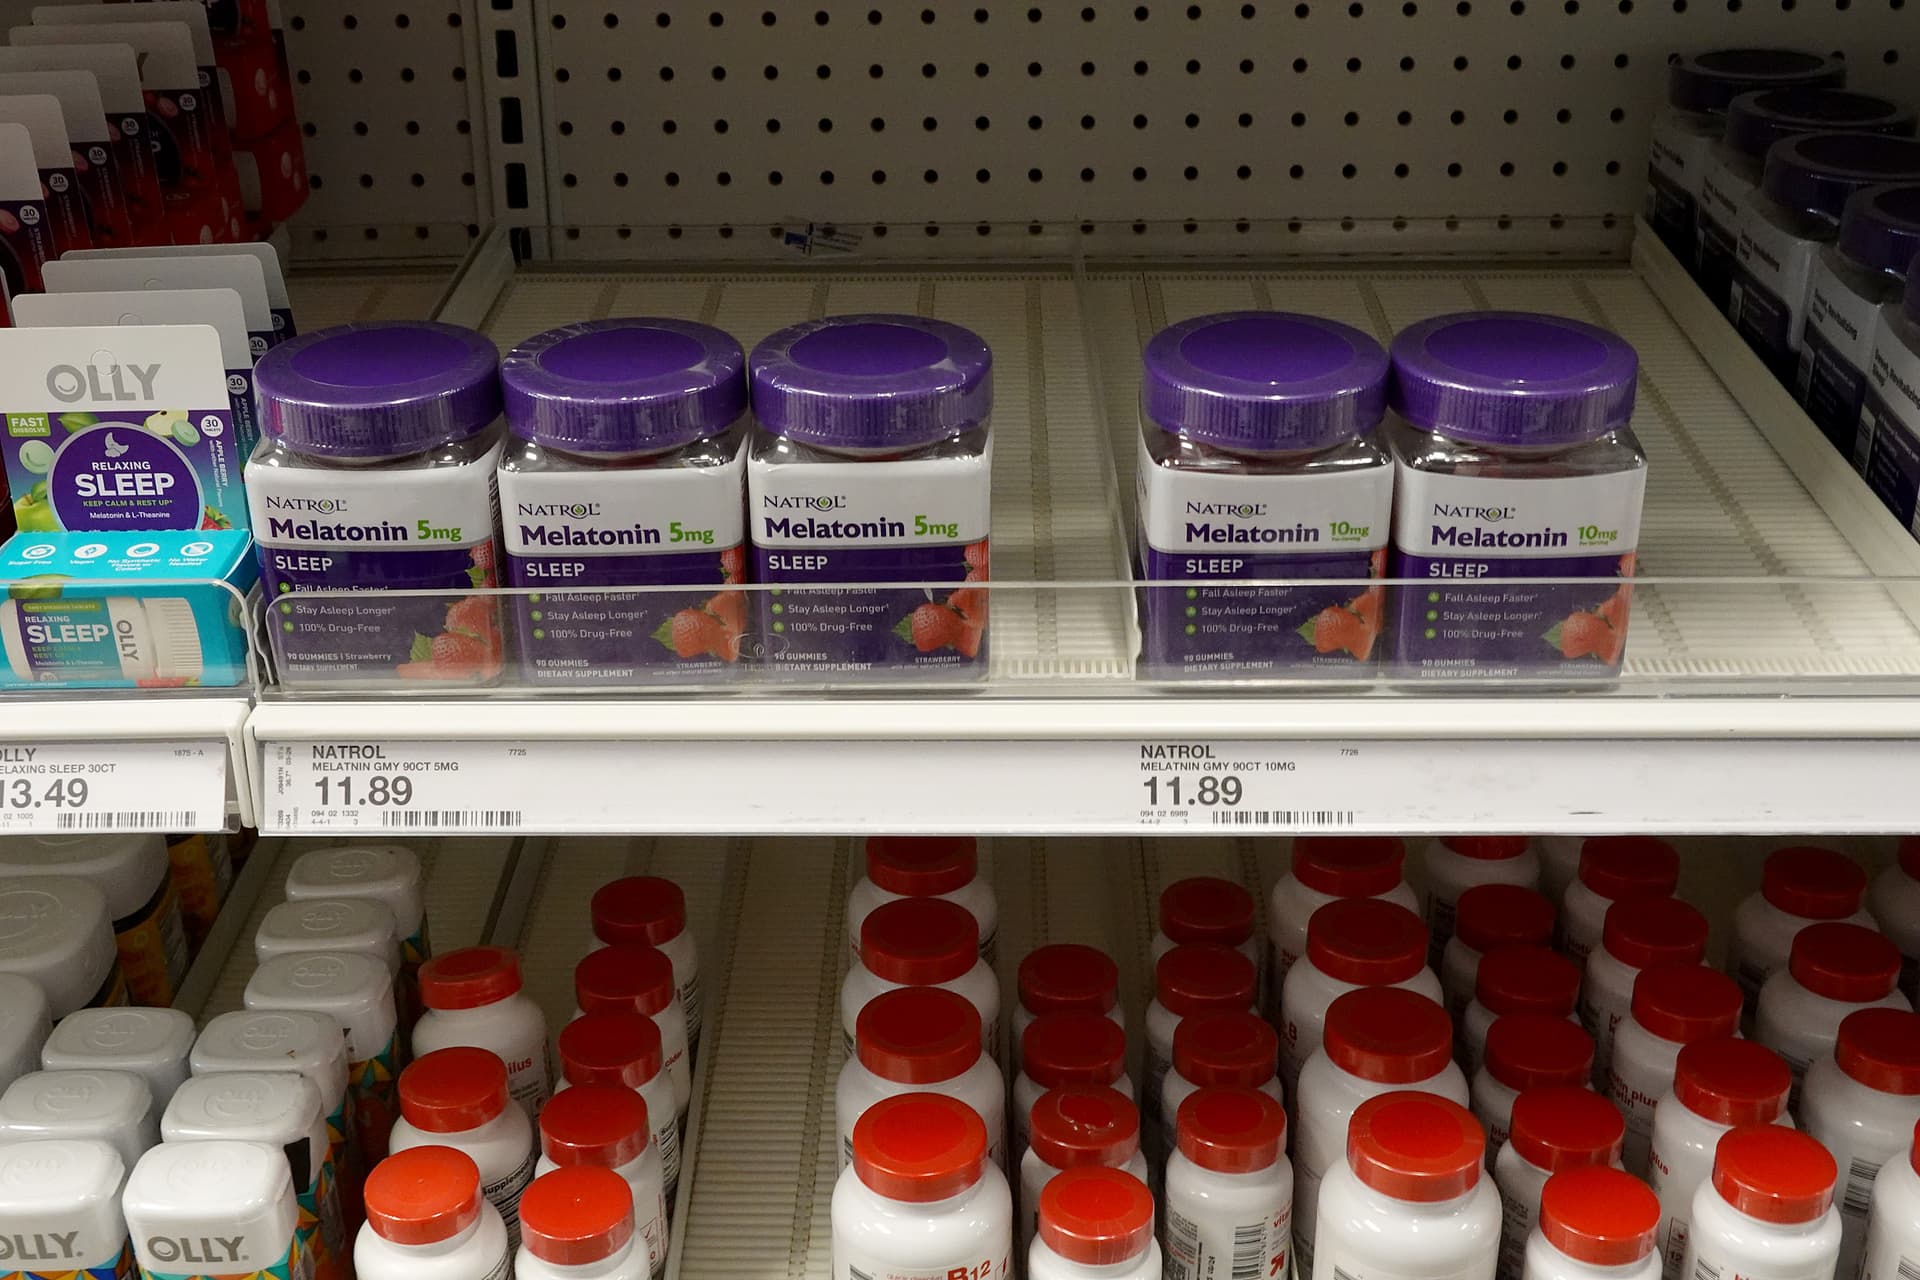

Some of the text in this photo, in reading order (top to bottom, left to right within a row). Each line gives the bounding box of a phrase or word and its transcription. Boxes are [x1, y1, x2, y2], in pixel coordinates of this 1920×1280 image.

[23, 208, 36, 217] 30
[46, 363, 162, 403] OLLY
[231, 378, 243, 386] 30
[11, 417, 44, 428] FAST
[205, 419, 219, 428] 30
[92, 461, 151, 471] RELAXING
[215, 440, 229, 488] APPLE BERRY
[74, 473, 175, 497] SLEEP
[89, 511, 124, 519] Melatonin
[269, 517, 462, 541] Melatonin 5mg
[764, 515, 958, 539] Melatonin 5mg
[1185, 521, 1369, 543] Melatonin 10mg
[520, 522, 714, 546] Melatonin 5mg
[1432, 525, 1617, 547] Melatonin 10mg
[276, 556, 332, 571] SLEEP
[769, 555, 828, 570] SLEEP
[1186, 559, 1243, 573] SLEEP
[527, 563, 585, 577] SLEEP
[1430, 563, 1488, 577] SLEEP
[546, 593, 564, 601] Fall
[567, 593, 601, 602] Asleep
[1202, 588, 1220, 598] Fall
[1223, 588, 1255, 598] Asleep
[1444, 593, 1464, 603] Fall
[1466, 594, 1500, 603] Asleep
[296, 605, 317, 615] Stay
[320, 606, 354, 616] Asleep
[788, 603, 811, 615] Stay
[812, 603, 847, 614] Asleep
[1202, 607, 1222, 616] Stay
[1224, 607, 1257, 617] Asleep
[548, 611, 569, 621] Stay
[572, 611, 606, 621] Asleep
[1443, 611, 1465, 621] Stay
[1467, 611, 1501, 621] Asleep
[299, 623, 380, 633] 100% Drug-Free
[790, 622, 873, 633] 100% Drug-Free
[1202, 623, 1279, 633] 100% Drug-Free
[27, 624, 109, 643] SLEEP
[550, 629, 632, 640] 100% Drug-Free
[1443, 629, 1523, 639] 100% Drug-Free
[116, 620, 139, 661] OLLY
[287, 652, 391, 661] 90 GUMMIES Strawberry
[787, 653, 827, 661] GUMMIES
[1195, 653, 1234, 661] GUMMIES
[548, 659, 589, 667] GUMMIES
[775, 663, 810, 671] DIETARY
[813, 662, 872, 671] SUPPLEMENT
[1184, 662, 1273, 672] DIETARY SUPPLEMENT
[537, 669, 633, 678] DIETARY SUPPLEMENT
[1421, 668, 1518, 678] DIETARY SUPPLEMENT
[312, 745, 386, 759] NATROL
[1141, 745, 1216, 759] NATROL
[0, 764, 116, 774] ELAXING SLEEP 30CT
[312, 762, 459, 771] MELATNIN GMY 90CT 5MG
[1141, 762, 1296, 771] MELATNIN GMY 90CT 10MG
[0, 778, 88, 808] 13.49
[314, 776, 413, 806] 11.89
[1143, 776, 1243, 806] 11.89
